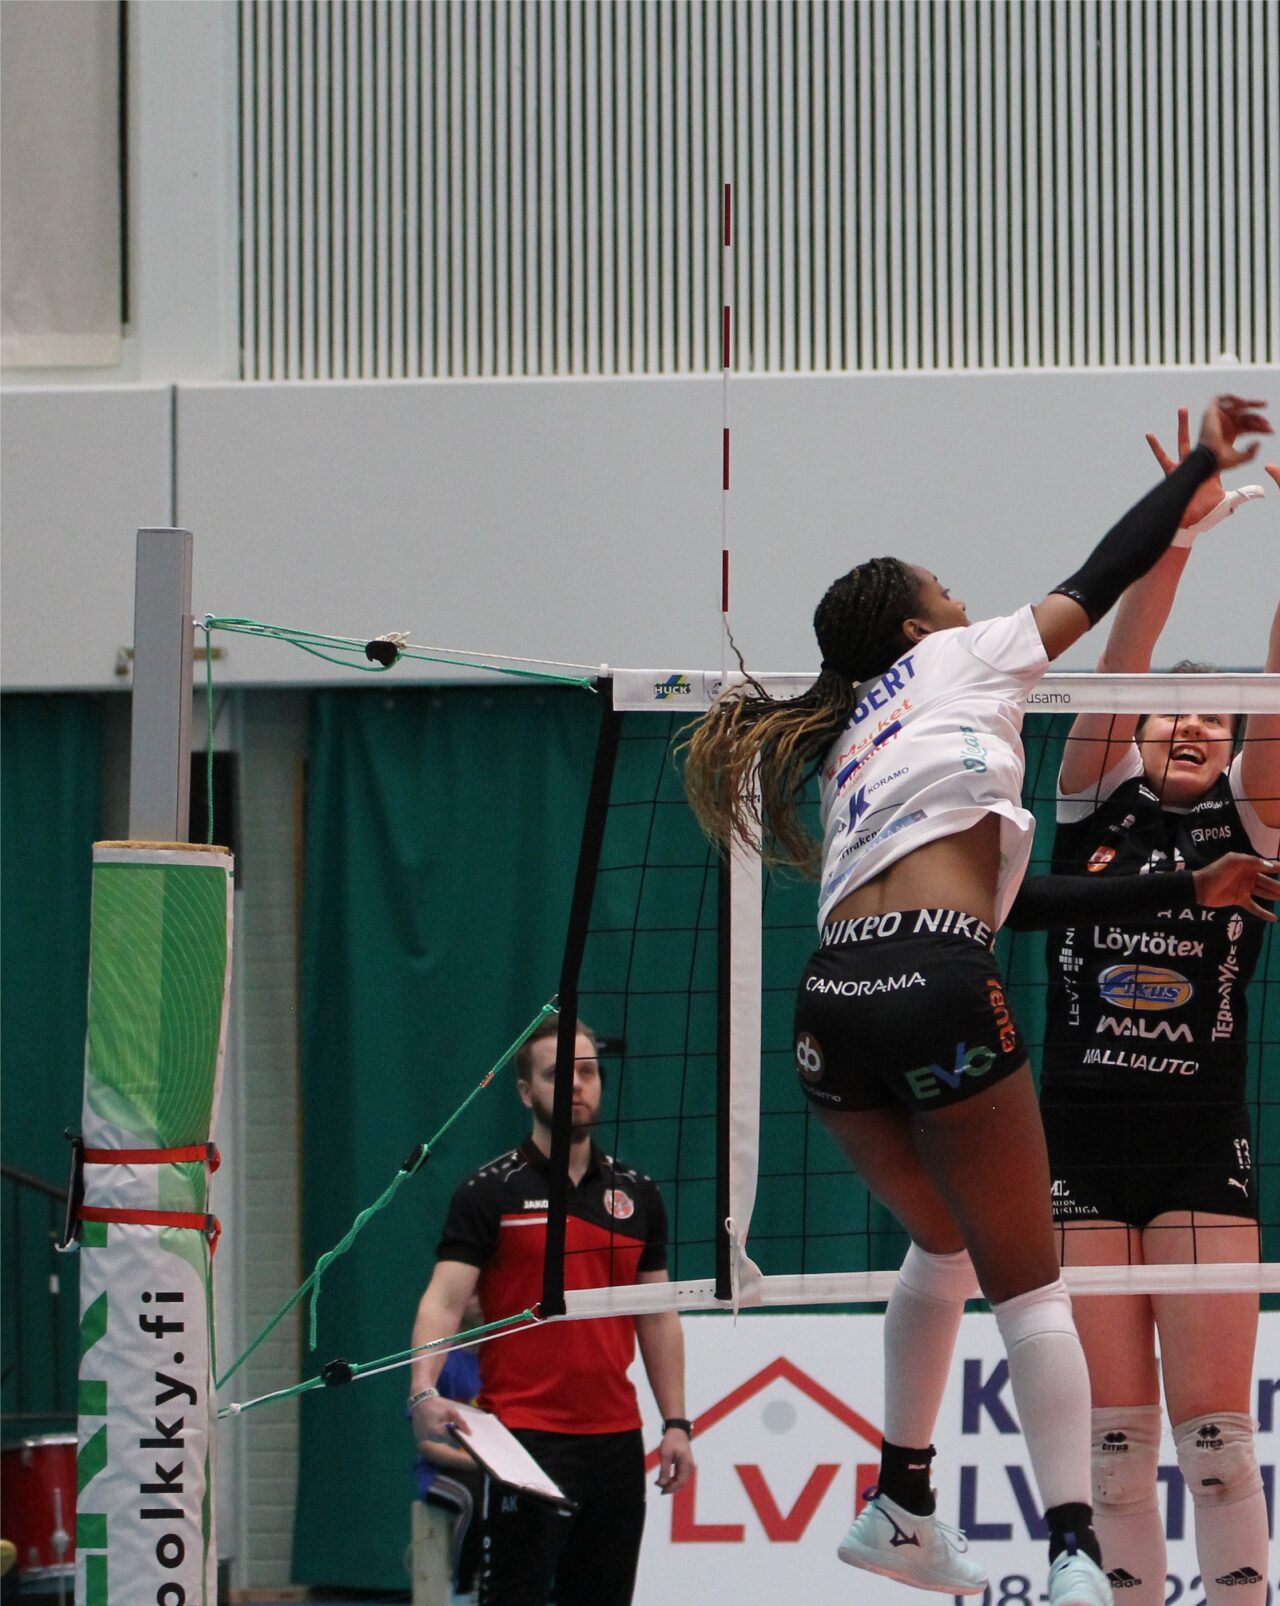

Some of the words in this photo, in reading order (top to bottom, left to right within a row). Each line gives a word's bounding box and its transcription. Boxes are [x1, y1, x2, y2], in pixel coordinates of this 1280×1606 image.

[654, 683, 691, 695] HUCK
[1026, 692, 1071, 704] usamo
[868, 766, 910, 794] KORAMO
[913, 908, 991, 946] NIKE
[1093, 925, 1204, 957] Löytötex
[904, 1041, 997, 1100] EVO
[1083, 1049, 1200, 1076] MALLIAUTO
[1110, 1577, 1142, 1589] idas
[1215, 1573, 1263, 1587] adidas
